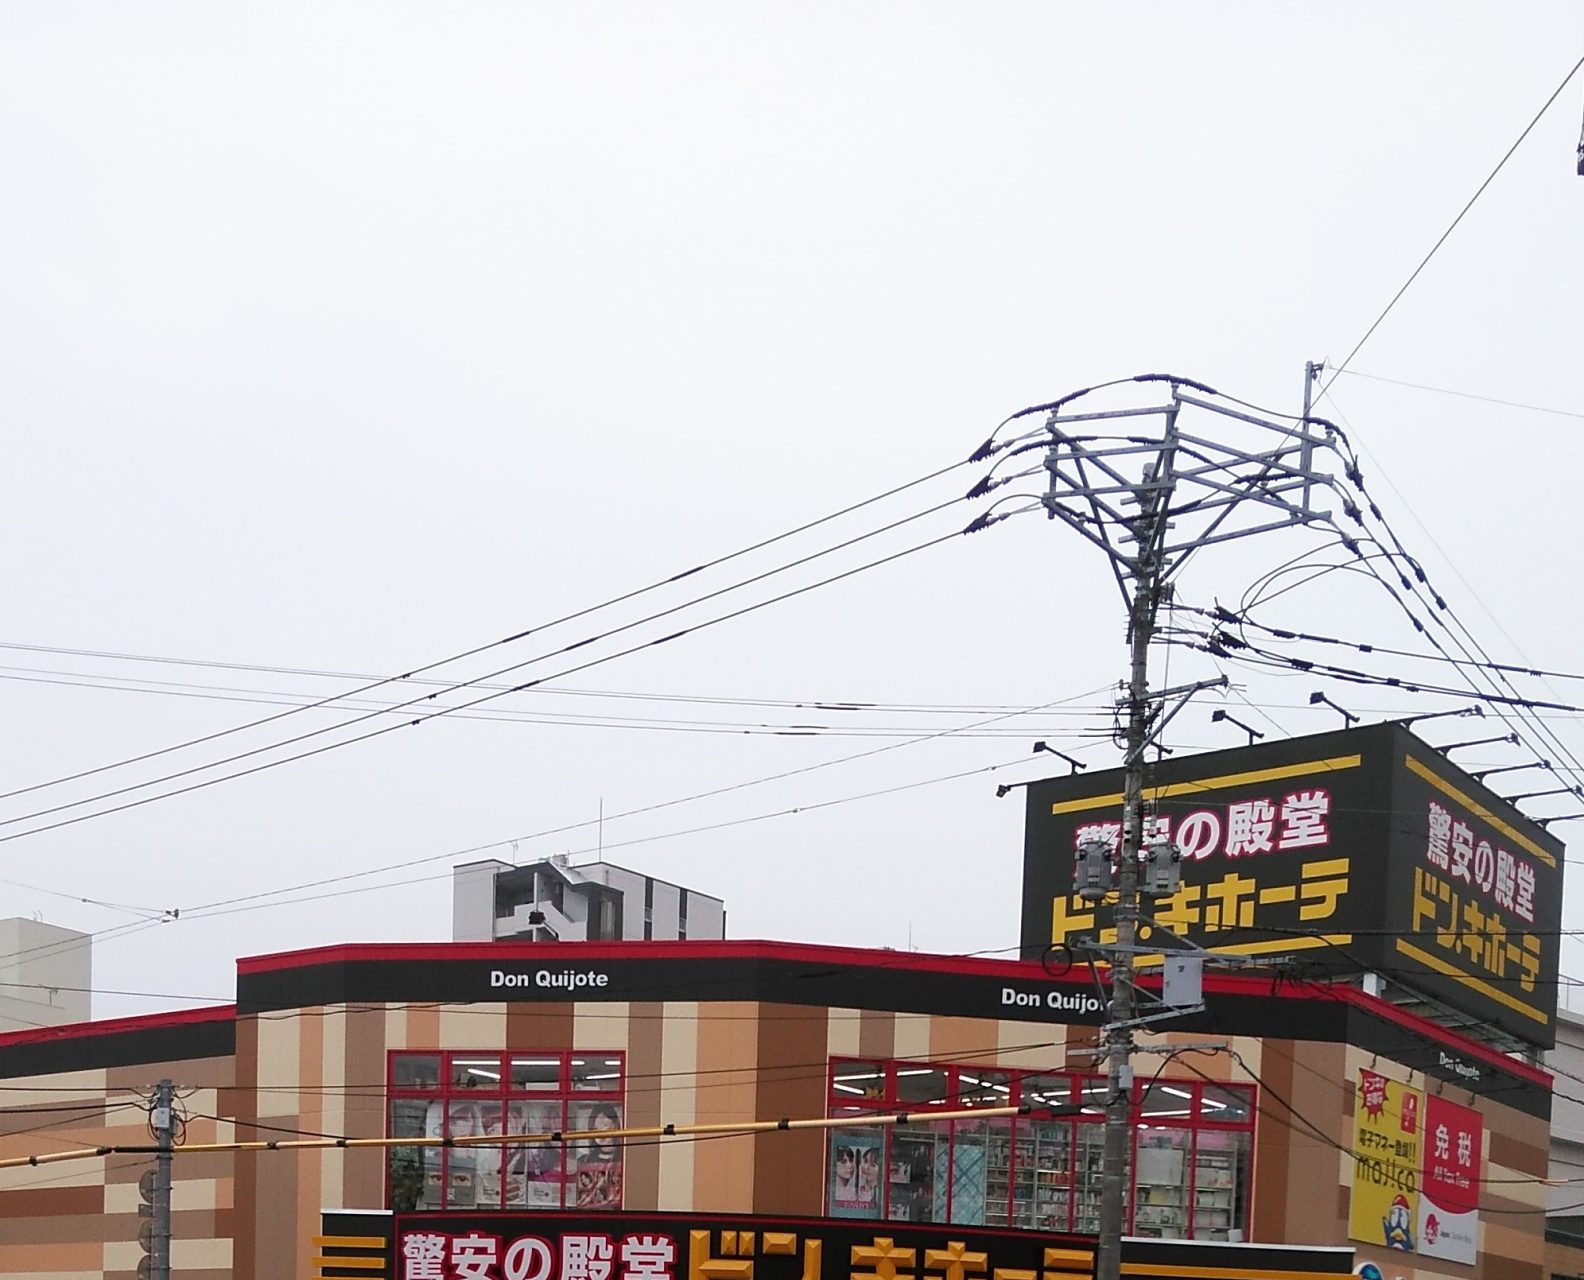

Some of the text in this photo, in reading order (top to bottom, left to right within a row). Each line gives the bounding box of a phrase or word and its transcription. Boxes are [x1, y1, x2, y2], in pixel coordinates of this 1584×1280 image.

[1427, 801, 1535, 923] 驚安の殿堂
[490, 970, 609, 991] Don Quijote
[1001, 988, 1040, 1007] Don
[1435, 1123, 1472, 1168] 免税
